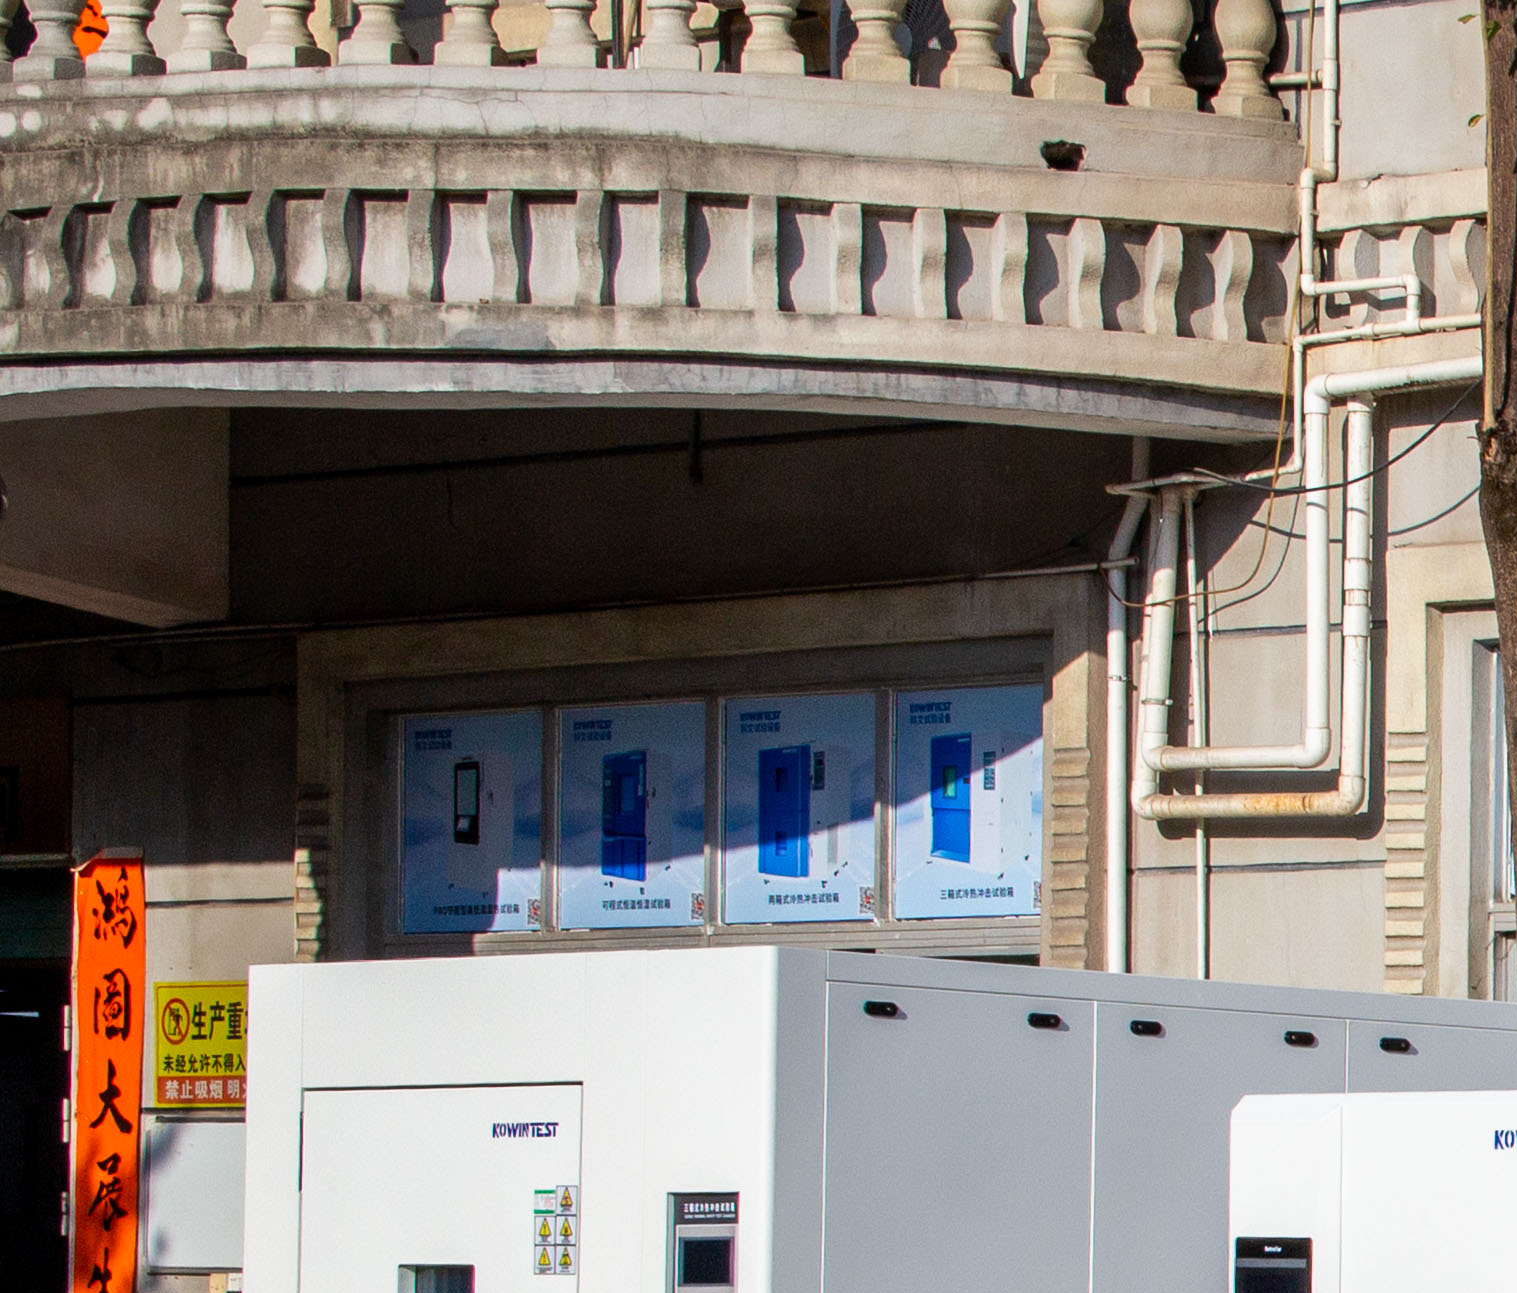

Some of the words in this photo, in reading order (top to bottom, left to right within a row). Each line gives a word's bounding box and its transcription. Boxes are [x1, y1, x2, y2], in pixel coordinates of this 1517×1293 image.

[191, 1001, 247, 1040] 生产重
[492, 1122, 559, 1138] KOWINTEST
